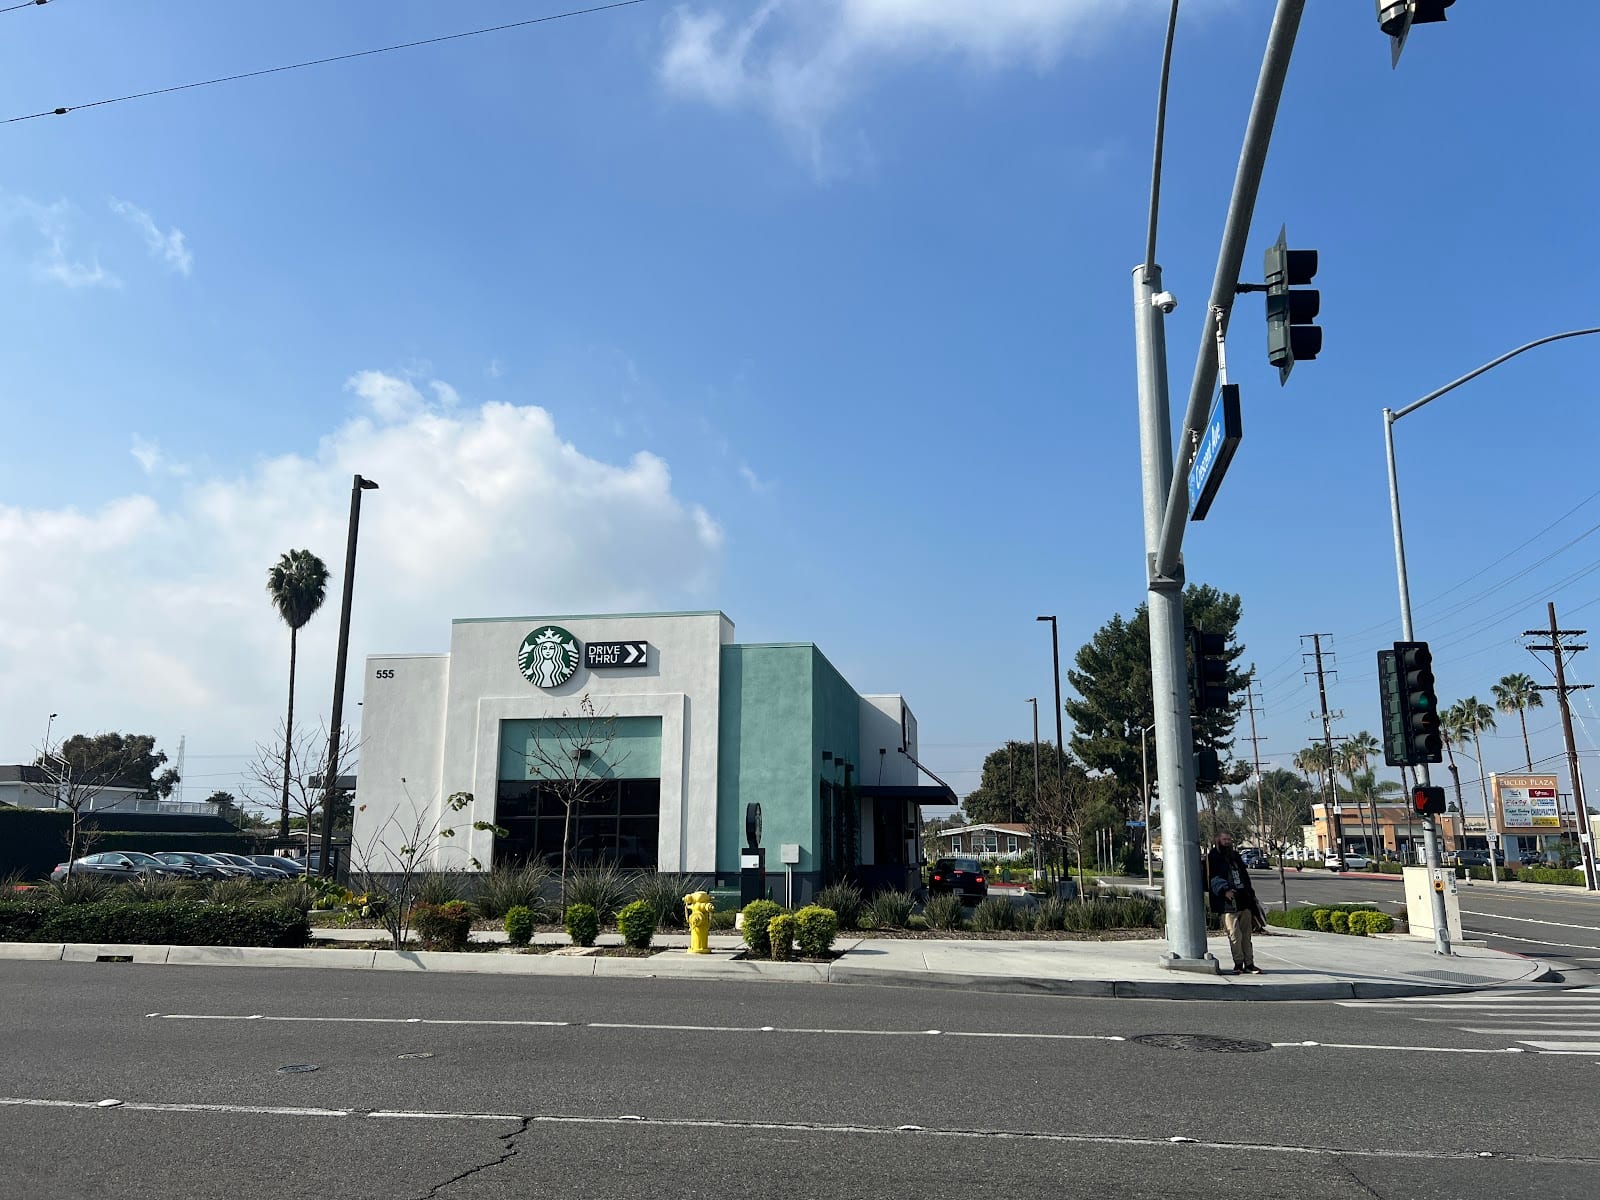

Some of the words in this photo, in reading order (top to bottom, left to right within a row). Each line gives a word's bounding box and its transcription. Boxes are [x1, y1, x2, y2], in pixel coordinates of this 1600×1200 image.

[1196, 440, 1212, 490] Crescent
[1211, 422, 1221, 454] Ave
[588, 645, 620, 655] DRIVE
[588, 654, 618, 664] THRU
[376, 669, 395, 679] 555
